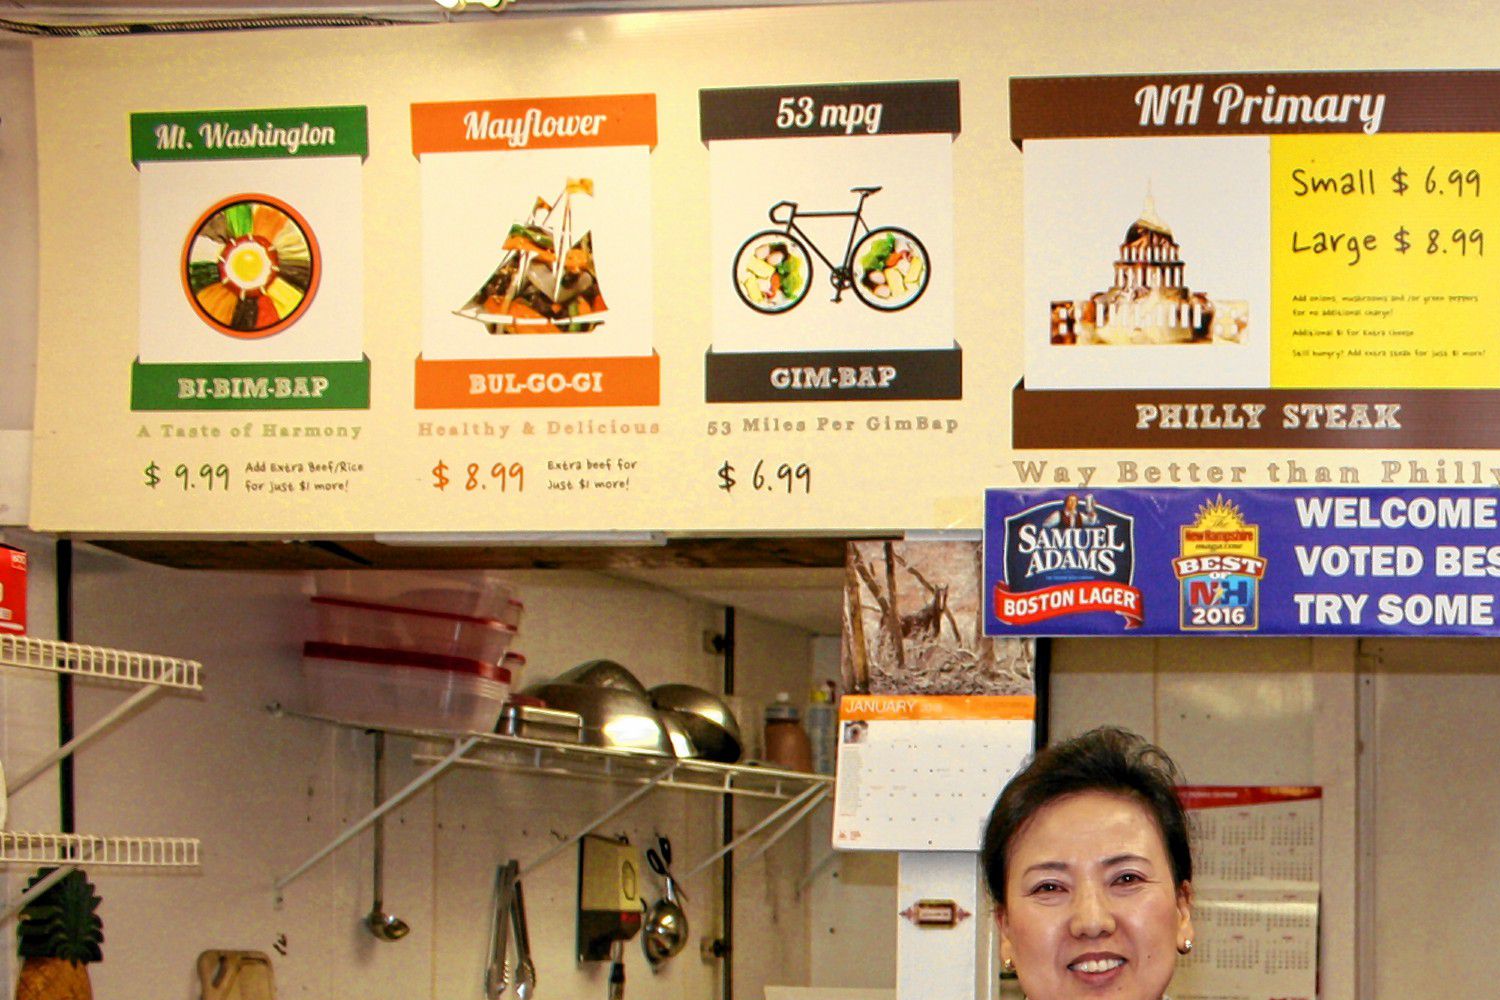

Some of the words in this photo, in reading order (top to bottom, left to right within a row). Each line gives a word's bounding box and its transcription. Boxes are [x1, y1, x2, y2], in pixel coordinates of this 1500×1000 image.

[776, 97, 813, 129] 53
[819, 102, 883, 135] mpg
[1134, 83, 1203, 126] NH
[1212, 84, 1387, 135] Primary
[155, 123, 193, 149] Mt.
[199, 121, 337, 154] Washington
[463, 108, 607, 148] Mayflower
[1292, 168, 1375, 196] Small
[1392, 166, 1409, 196] $
[1424, 166, 1481, 198] 6.99
[1292, 230, 1378, 266] Large
[1393, 226, 1411, 255] $
[1426, 228, 1485, 257] 8.99
[177, 375, 329, 399] BI-BIM-BAP
[469, 372, 604, 394] BUL-GO-GI
[770, 366, 897, 389] GIM-BAP
[137, 424, 151, 437] A
[161, 423, 221, 437] Taste
[230, 422, 253, 437] of
[262, 423, 362, 439] Harmony
[418, 421, 511, 439] Healthy
[521, 422, 535, 436] &
[547, 419, 660, 435] Delicious
[707, 421, 732, 436] 53
[742, 417, 806, 432] Miles
[817, 416, 856, 431] Per
[866, 415, 959, 434] GimBap
[1136, 403, 1266, 431] PHILLY
[1283, 403, 1402, 430] STEAK
[144, 460, 161, 489] $
[175, 463, 230, 491] 9.99
[245, 460, 266, 473] Add
[270, 462, 304, 473] Extra
[308, 460, 364, 474] Beef/Rice
[431, 459, 450, 491] $
[465, 462, 525, 493] 8.99
[547, 460, 582, 471] Extra
[587, 458, 612, 471] beef
[617, 458, 638, 471] for
[717, 460, 736, 493] $
[753, 459, 812, 494] 6.99
[1012, 460, 1097, 489] Way
[1118, 461, 1247, 484] Better
[1267, 460, 1360, 484] than
[245, 480, 264, 493] for
[314, 479, 349, 492] more!
[594, 476, 630, 491] more!
[1294, 497, 1498, 529] WELCOME
[1018, 522, 1126, 553] SAMUEL
[1024, 551, 1117, 577] ADAMS
[1176, 555, 1264, 576] BEST
[1294, 546, 1424, 577] VOTED
[1208, 571, 1230, 580] OF
[1003, 590, 1076, 618] BOSTON
[1078, 585, 1139, 610] LAGER
[1189, 581, 1249, 607] NH
[1191, 607, 1246, 625] 2016
[1293, 593, 1369, 625] TRY
[1377, 594, 1495, 626] SOME
[845, 700, 917, 714] JANUARY
